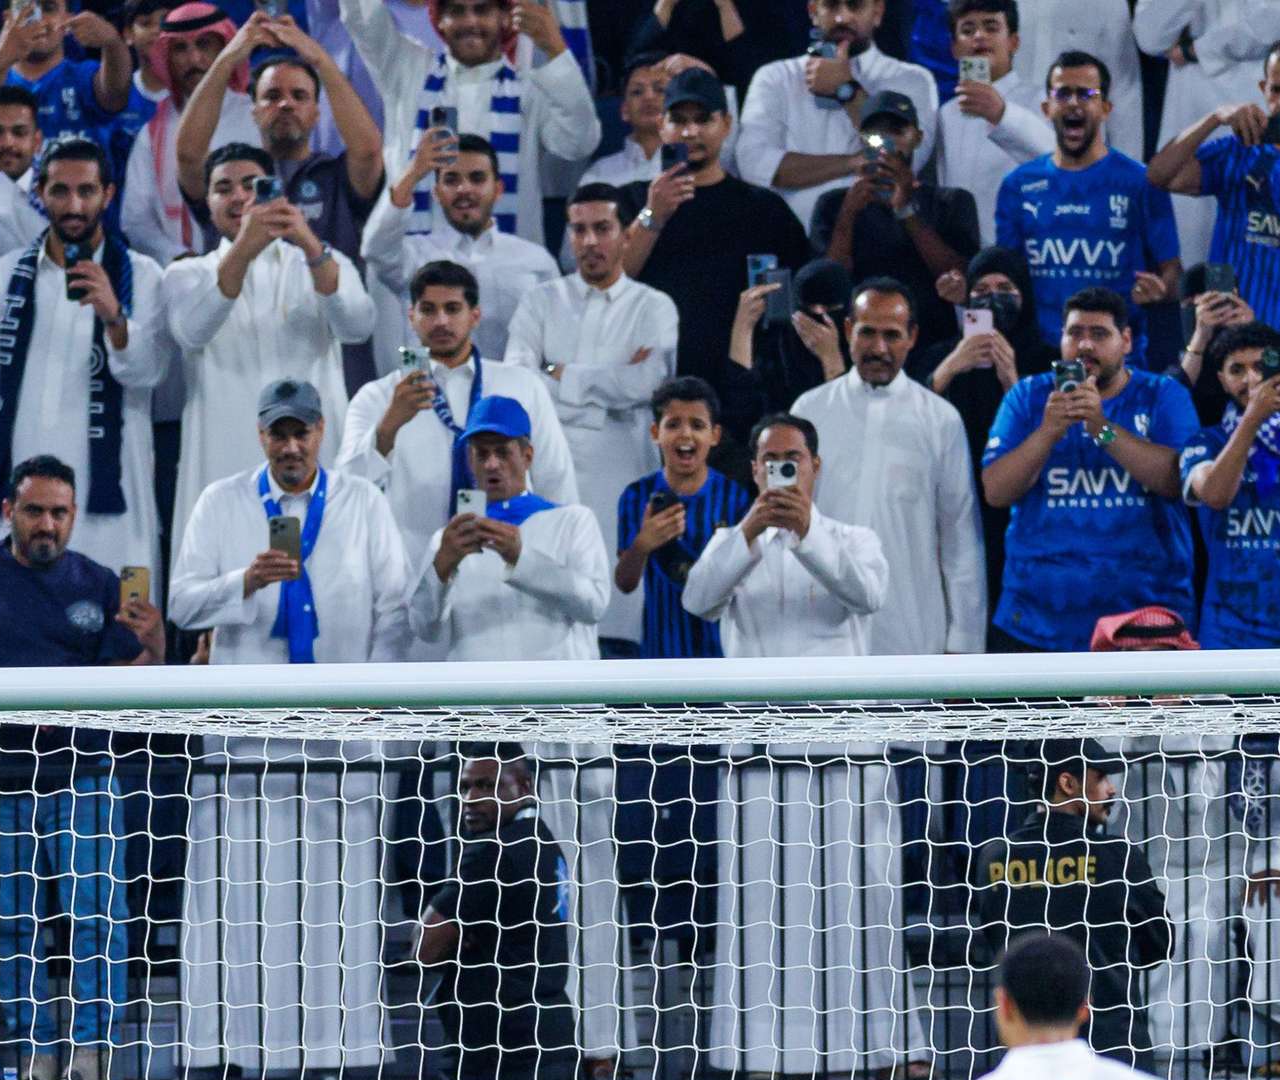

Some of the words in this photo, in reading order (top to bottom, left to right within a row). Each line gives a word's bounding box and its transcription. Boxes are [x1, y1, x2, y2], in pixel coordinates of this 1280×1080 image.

[1025, 238, 1125, 267] SAVVY
[1047, 468, 1132, 496] SAVV
[1047, 497, 1099, 509] GAMES
[1105, 497, 1145, 509] GROU
[989, 856, 1097, 891] POLICE
